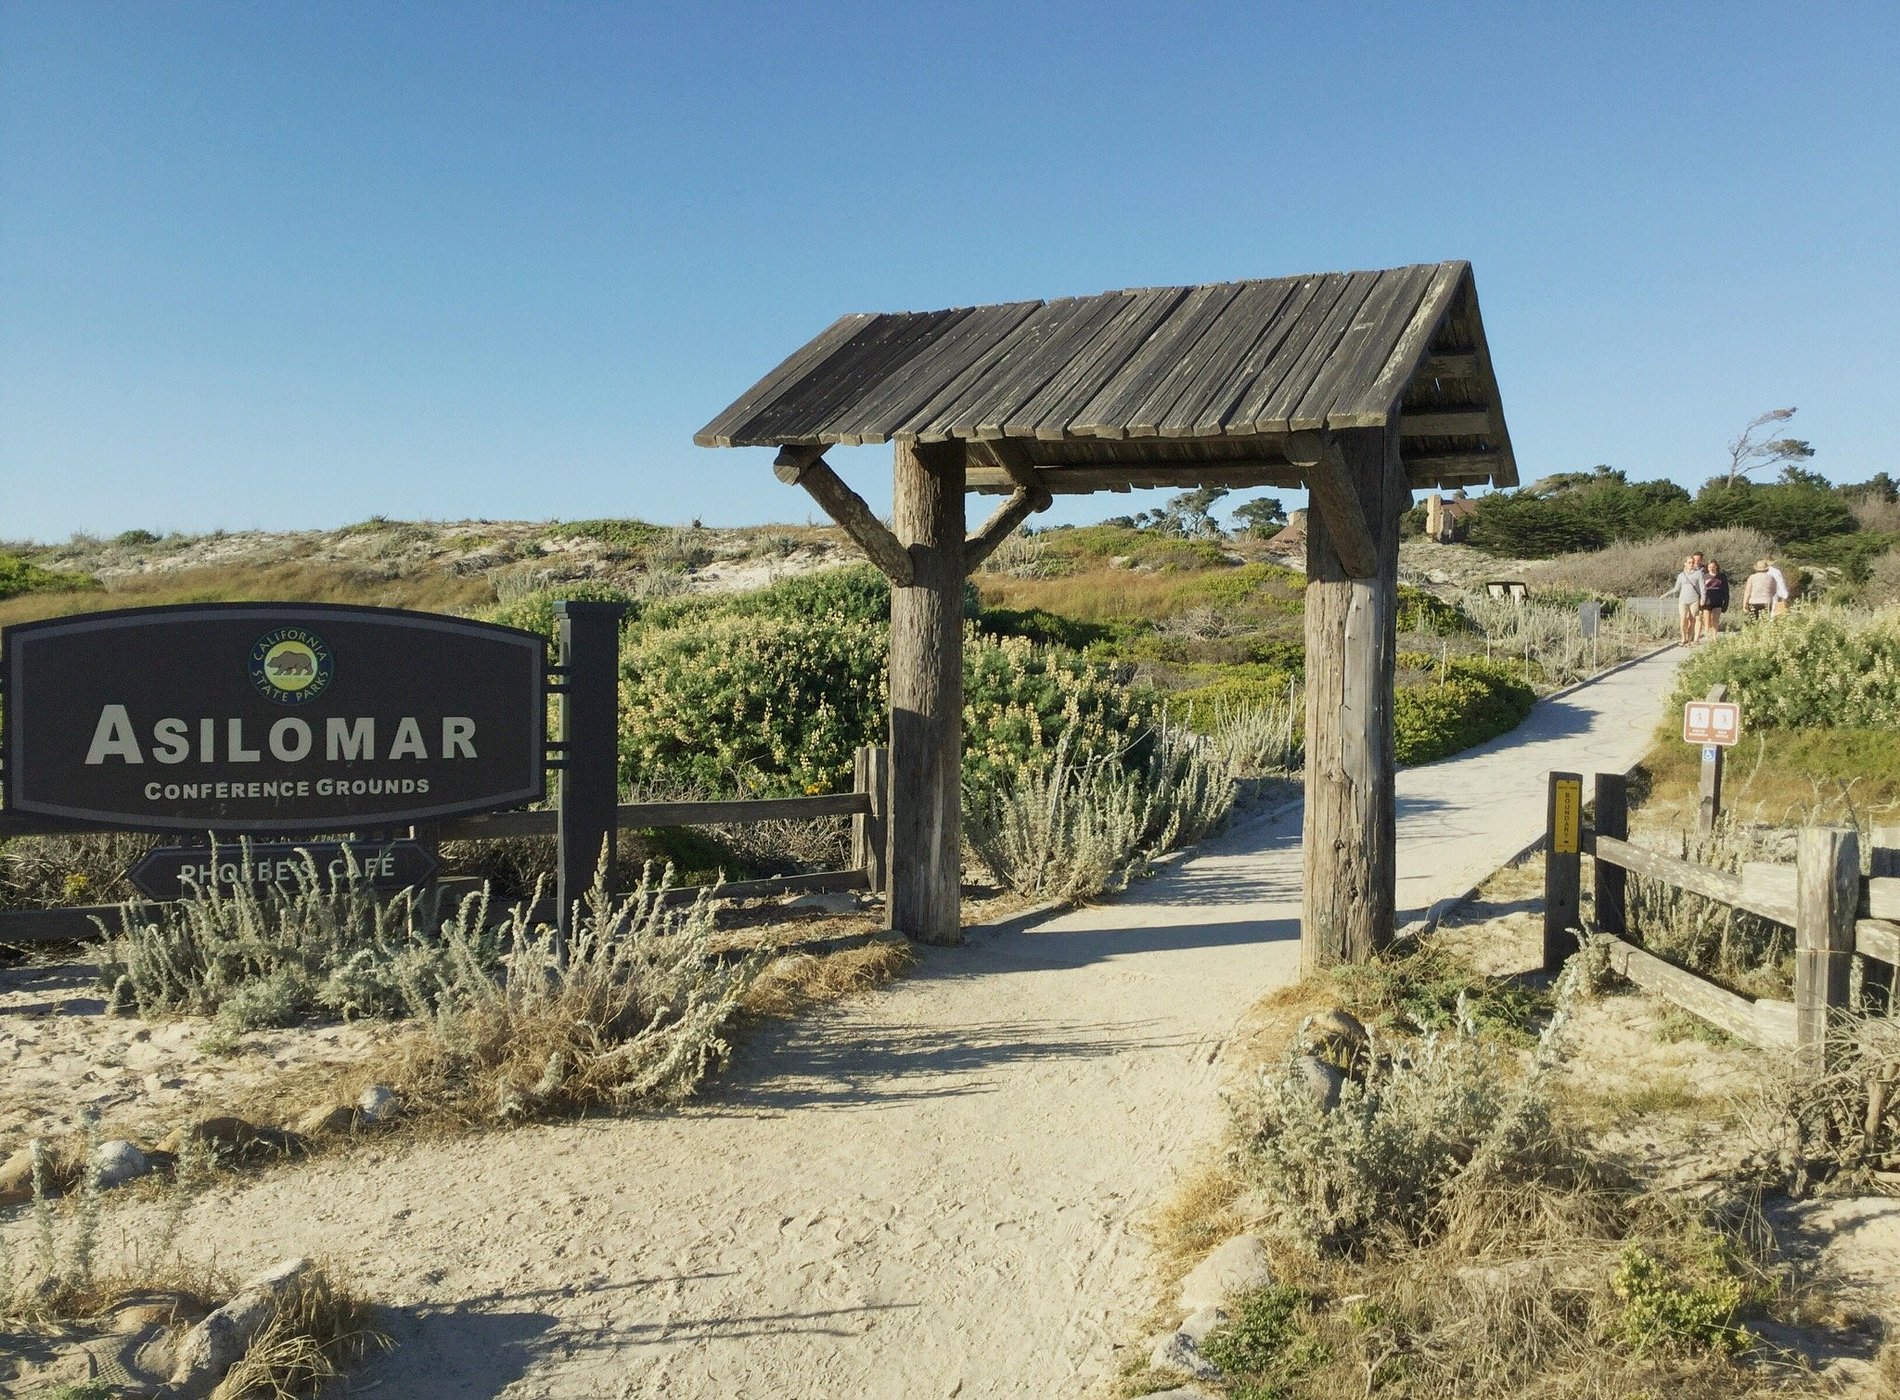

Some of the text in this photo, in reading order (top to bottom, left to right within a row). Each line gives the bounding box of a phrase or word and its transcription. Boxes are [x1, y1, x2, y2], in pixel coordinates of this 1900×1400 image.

[253, 630, 327, 662] CALIFORNIA
[252, 670, 328, 702] STATE PARKS
[85, 704, 478, 764] ASILOMAR
[144, 778, 430, 800] CONFERENCE GROUNDS
[1563, 792, 1571, 837] BOUNDARY
